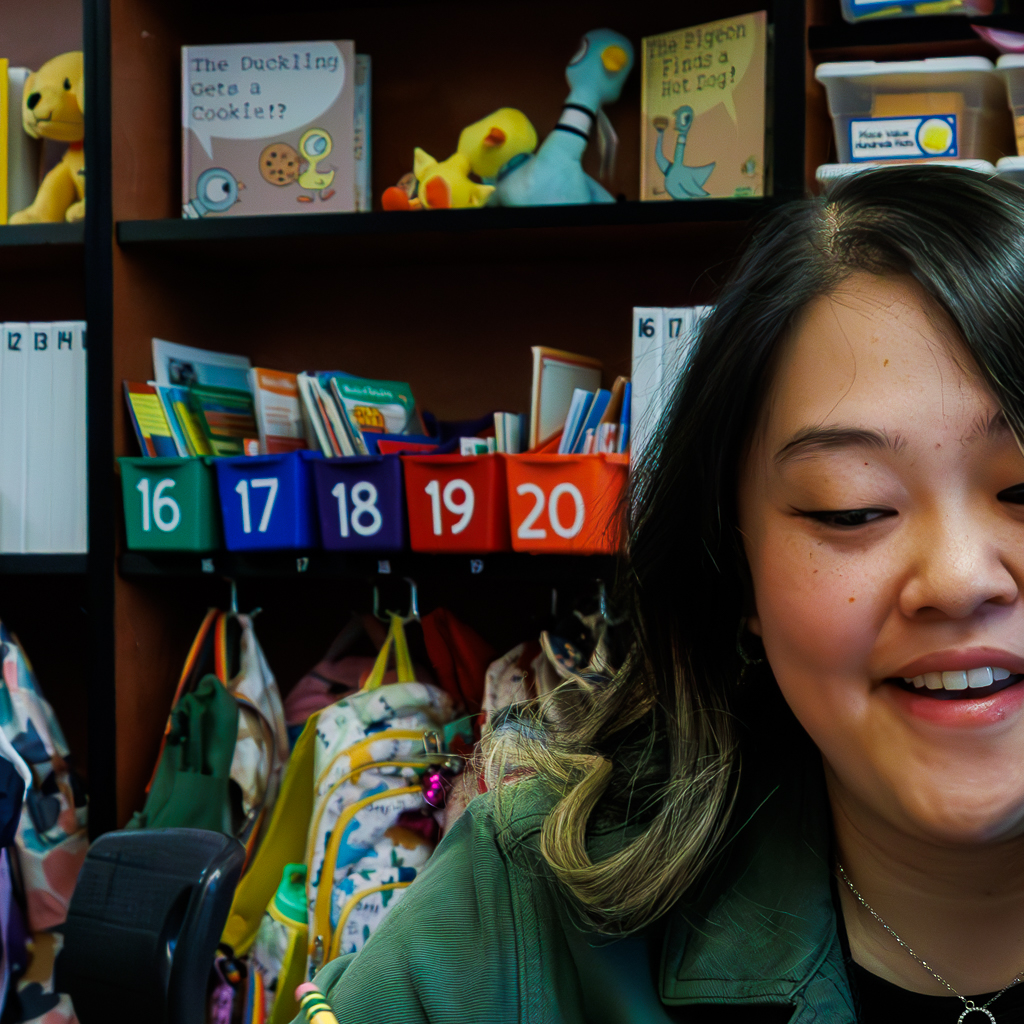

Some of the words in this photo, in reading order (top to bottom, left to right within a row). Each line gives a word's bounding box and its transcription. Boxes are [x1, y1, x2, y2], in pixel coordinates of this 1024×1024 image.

[684, 23, 746, 50] Pigeon
[191, 56, 229, 72] The
[240, 52, 340, 72] Duckling
[662, 53, 712, 76] Finds
[718, 51, 729, 63] a
[190, 81, 239, 97] Gets
[249, 82, 261, 96] a
[661, 79, 690, 97] Hot
[696, 65, 736, 91] Dog!
[191, 102, 287, 121] Cookie!?
[638, 317, 655, 338] 16
[668, 318, 683, 338] 17
[8, 331, 22, 351] 12
[34, 331, 48, 351] 13
[58, 331, 72, 350] 14
[136, 478, 181, 532] 16
[235, 477, 279, 534] 17
[331, 480, 383, 538] 18
[424, 478, 475, 536] 19
[515, 482, 585, 540] 20
[470, 559, 484, 574] 19
